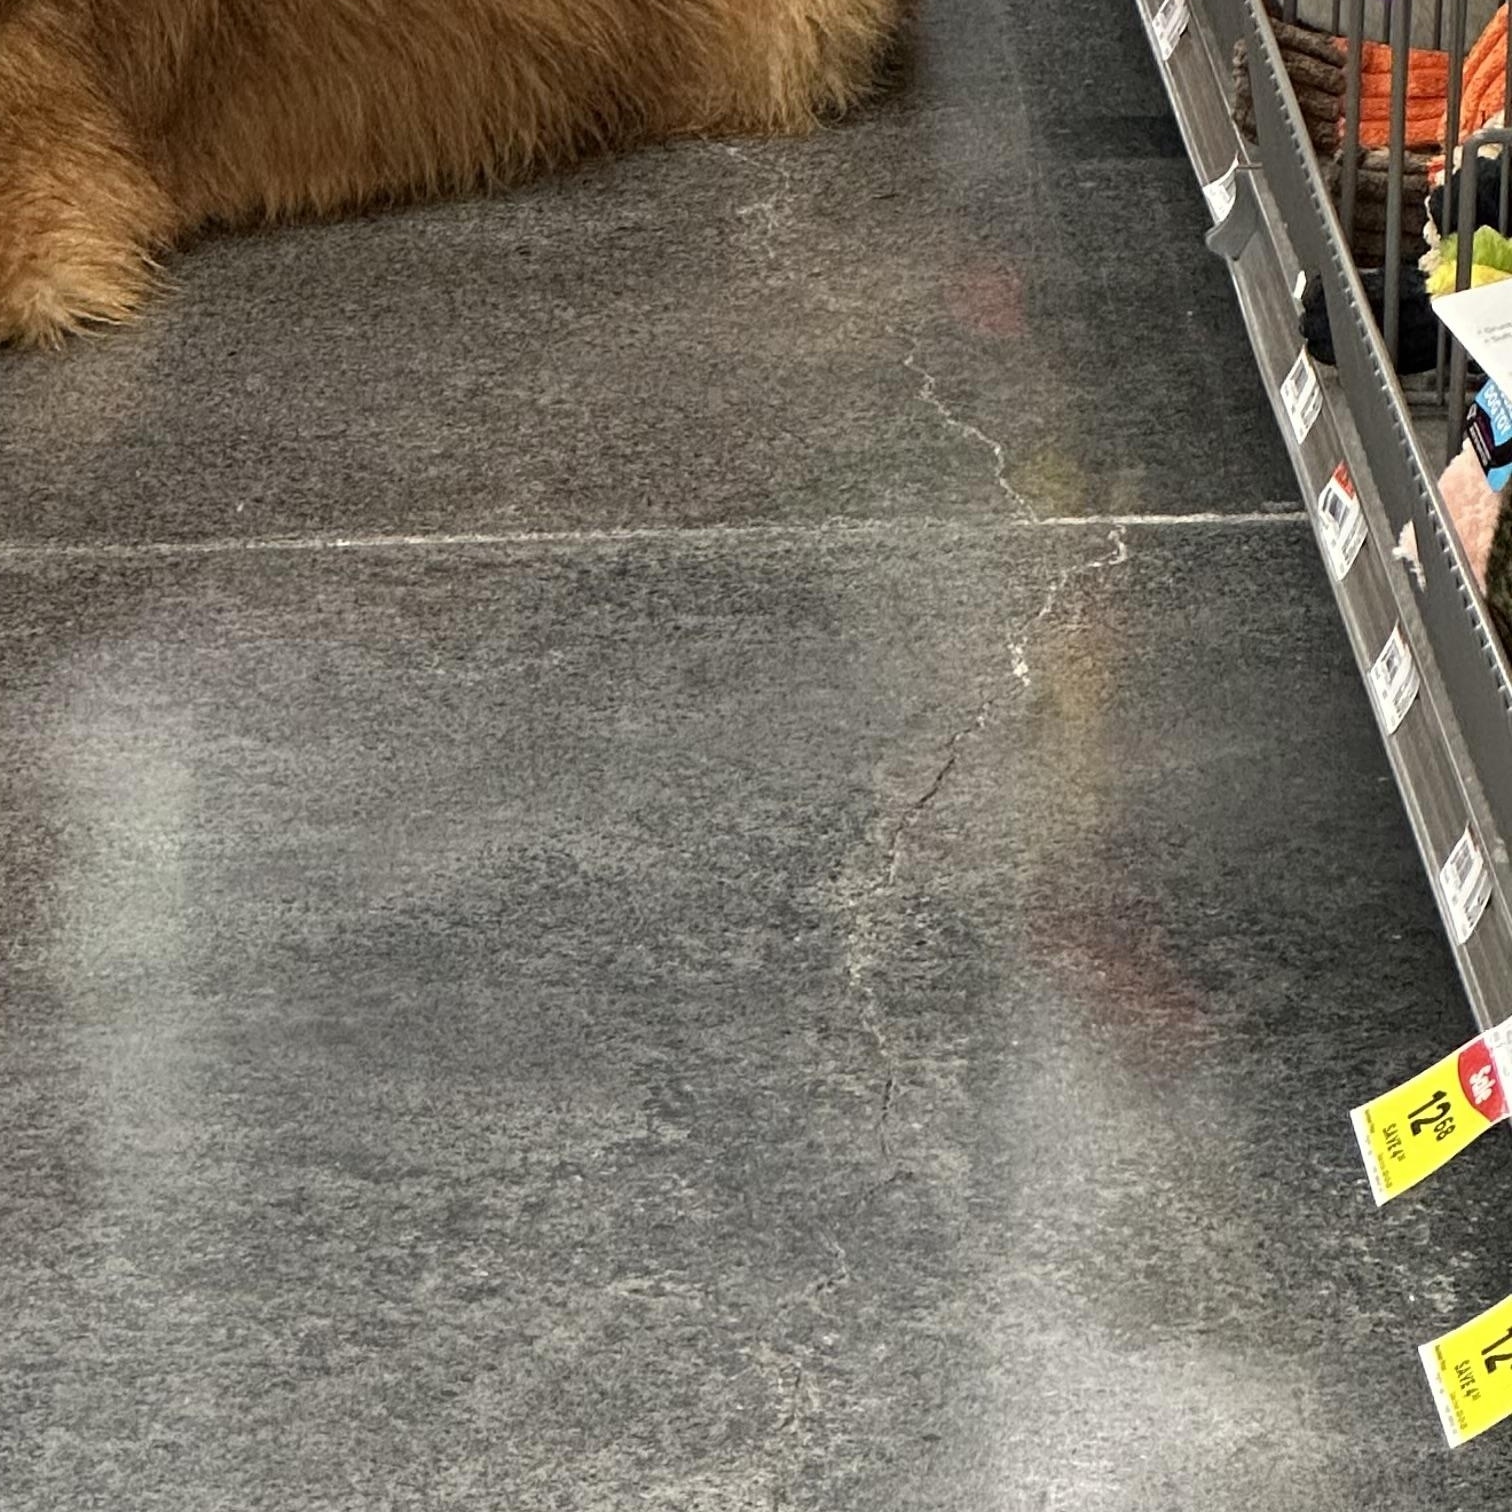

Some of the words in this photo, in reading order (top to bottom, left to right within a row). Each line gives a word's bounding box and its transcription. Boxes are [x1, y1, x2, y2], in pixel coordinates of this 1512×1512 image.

[1469, 1064, 1496, 1105] Sale
[1382, 1122, 1402, 1151] SAVE
[1454, 1359, 1475, 1390] SAVE
